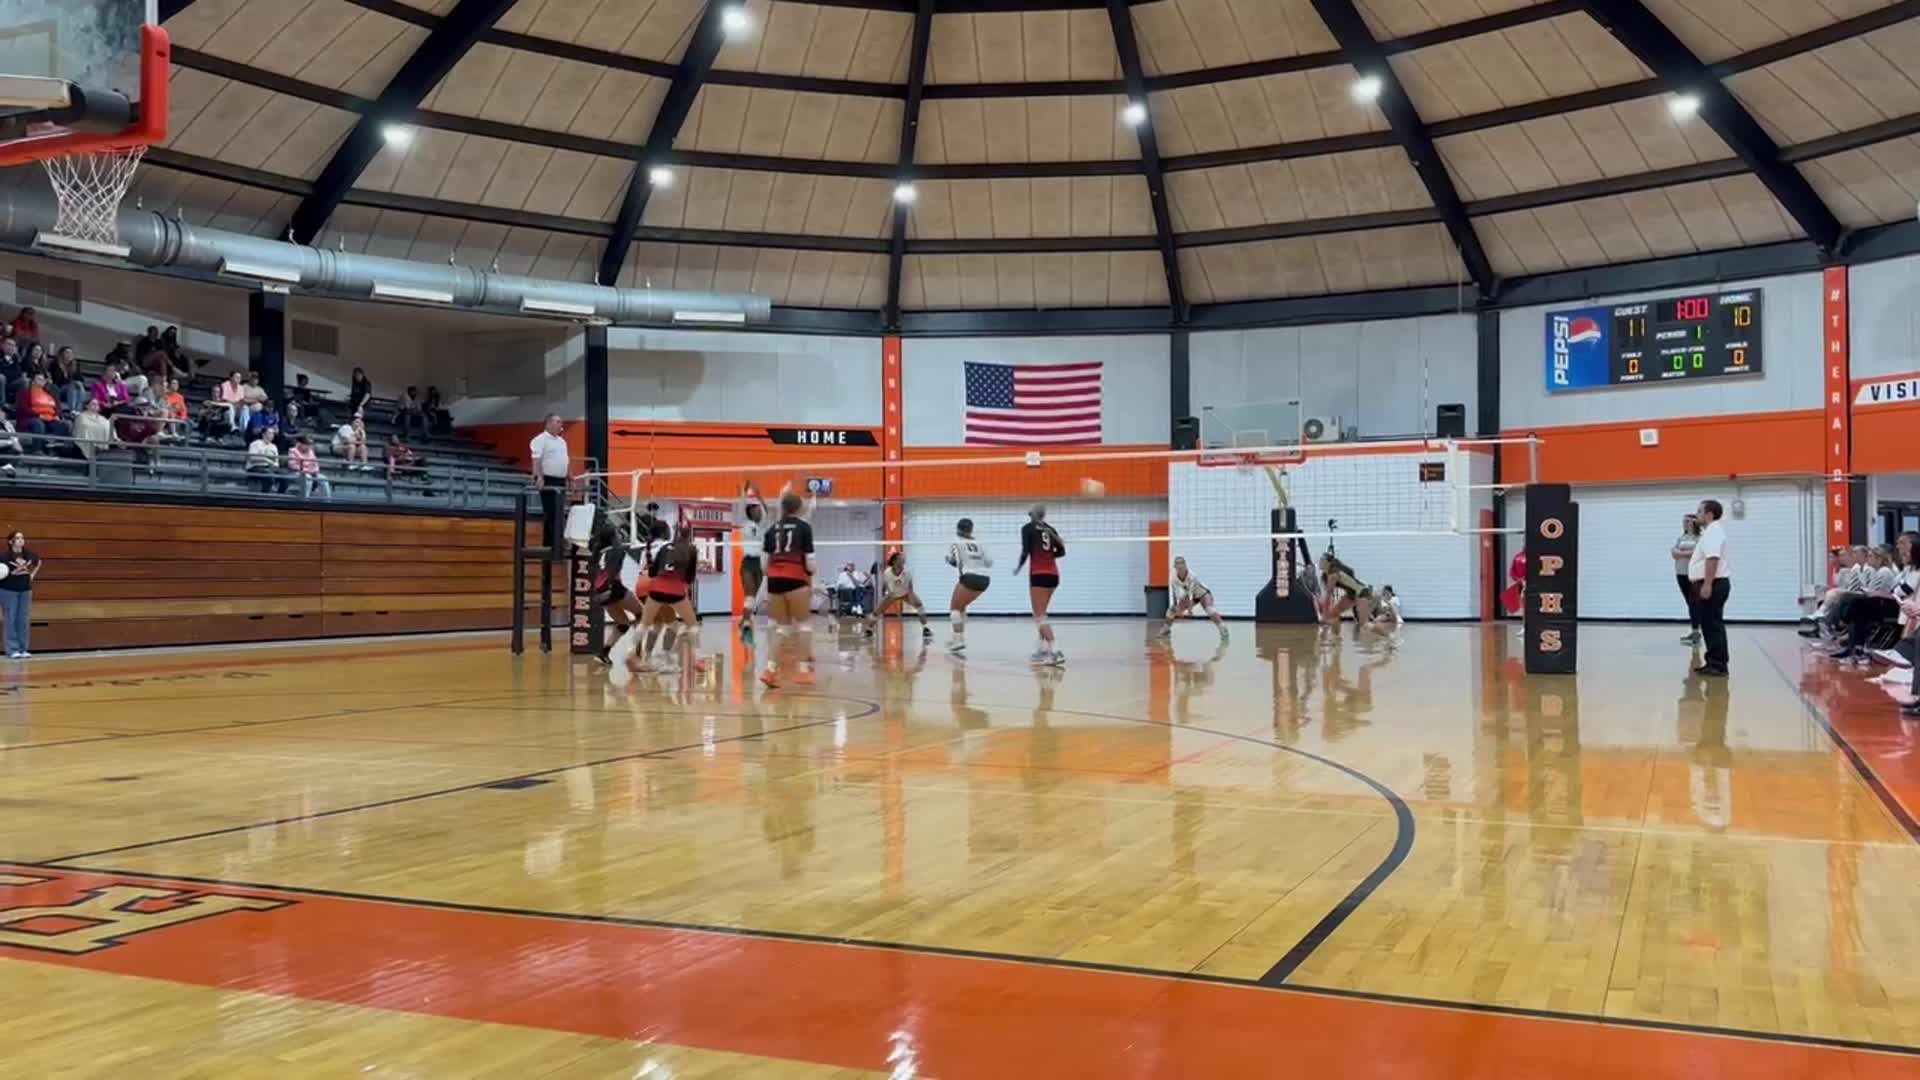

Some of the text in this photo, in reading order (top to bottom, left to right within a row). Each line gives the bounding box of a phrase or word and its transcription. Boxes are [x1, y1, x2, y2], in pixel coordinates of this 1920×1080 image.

[1614, 304, 1648, 317] GUEST
[1734, 306, 1751, 327] 10
[1629, 317, 1646, 338] 11
[1554, 316, 1570, 386] PEPSI
[1733, 350, 1744, 365] 0
[1629, 359, 1639, 374] 0
[1673, 353, 1703, 370] 0 0
[1871, 380, 1917, 401] VISI
[797, 431, 847, 445] HOME
[1539, 518, 1565, 652] OPHS
